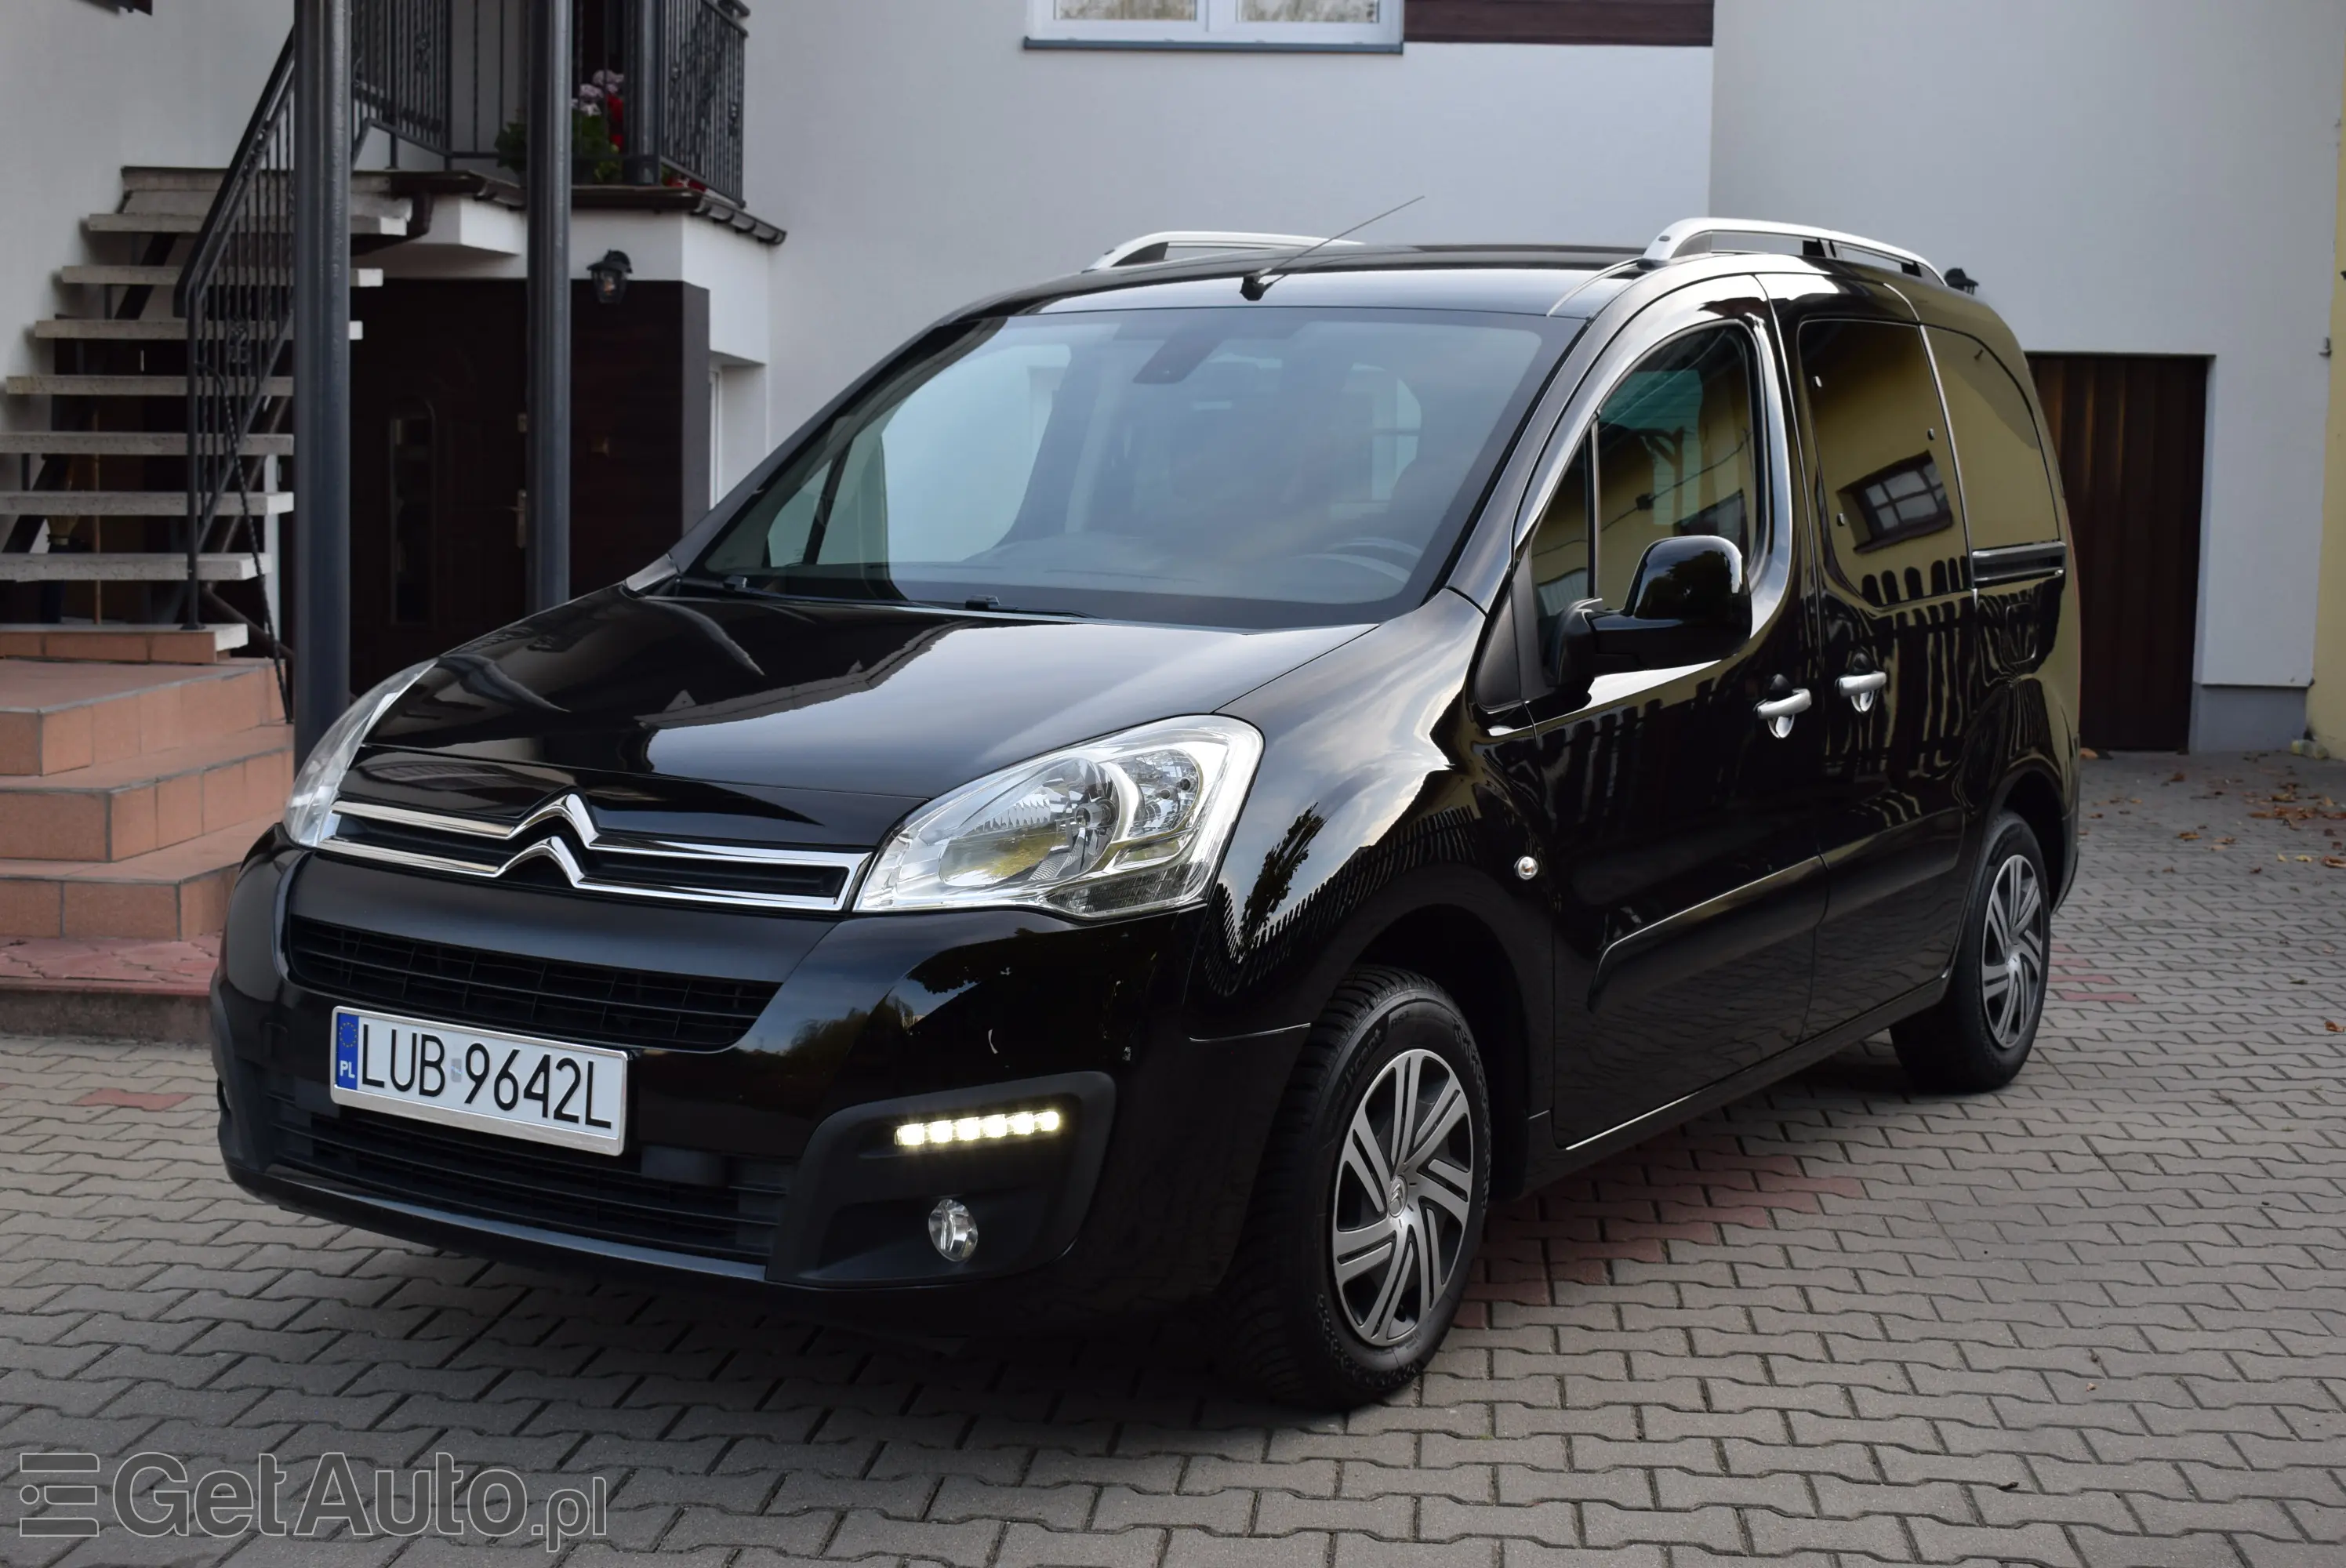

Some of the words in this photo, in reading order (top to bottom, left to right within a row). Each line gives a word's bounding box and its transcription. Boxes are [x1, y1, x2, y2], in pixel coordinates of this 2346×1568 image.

[340, 1059, 355, 1079] PL
[362, 1023, 445, 1098] LUB
[463, 1042, 612, 1130] 9642L
